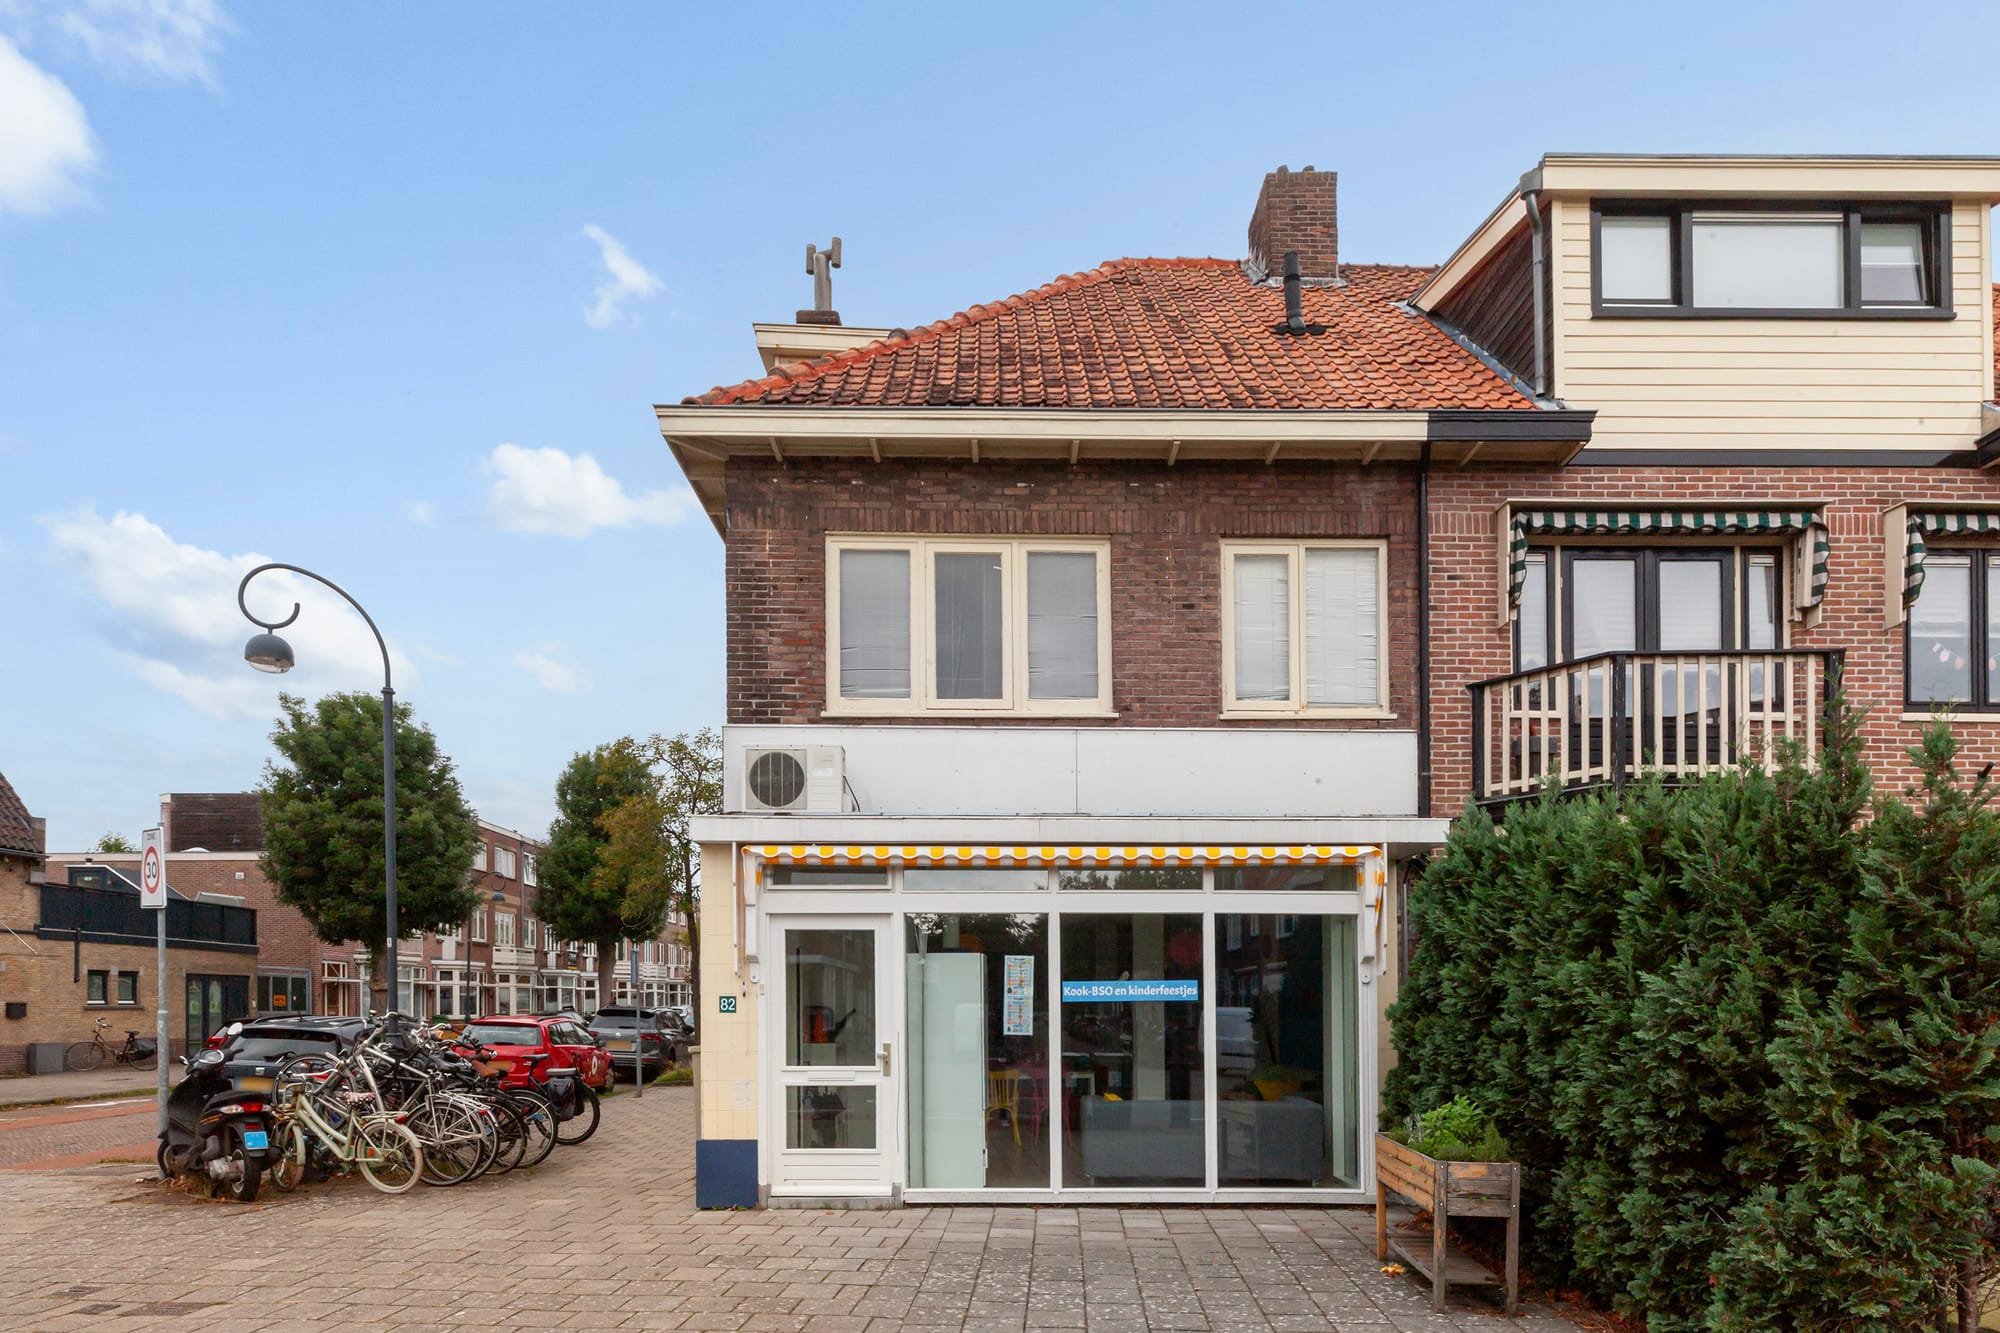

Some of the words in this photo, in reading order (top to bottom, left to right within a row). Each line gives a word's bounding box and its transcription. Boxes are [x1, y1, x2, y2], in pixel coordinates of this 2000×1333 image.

[146, 861, 157, 879] 30
[1064, 985, 1113, 996] Kook-BSO
[1114, 987, 1127, 996] en
[1128, 984, 1197, 998] kinderfeestjes
[720, 998, 735, 1010] 82
